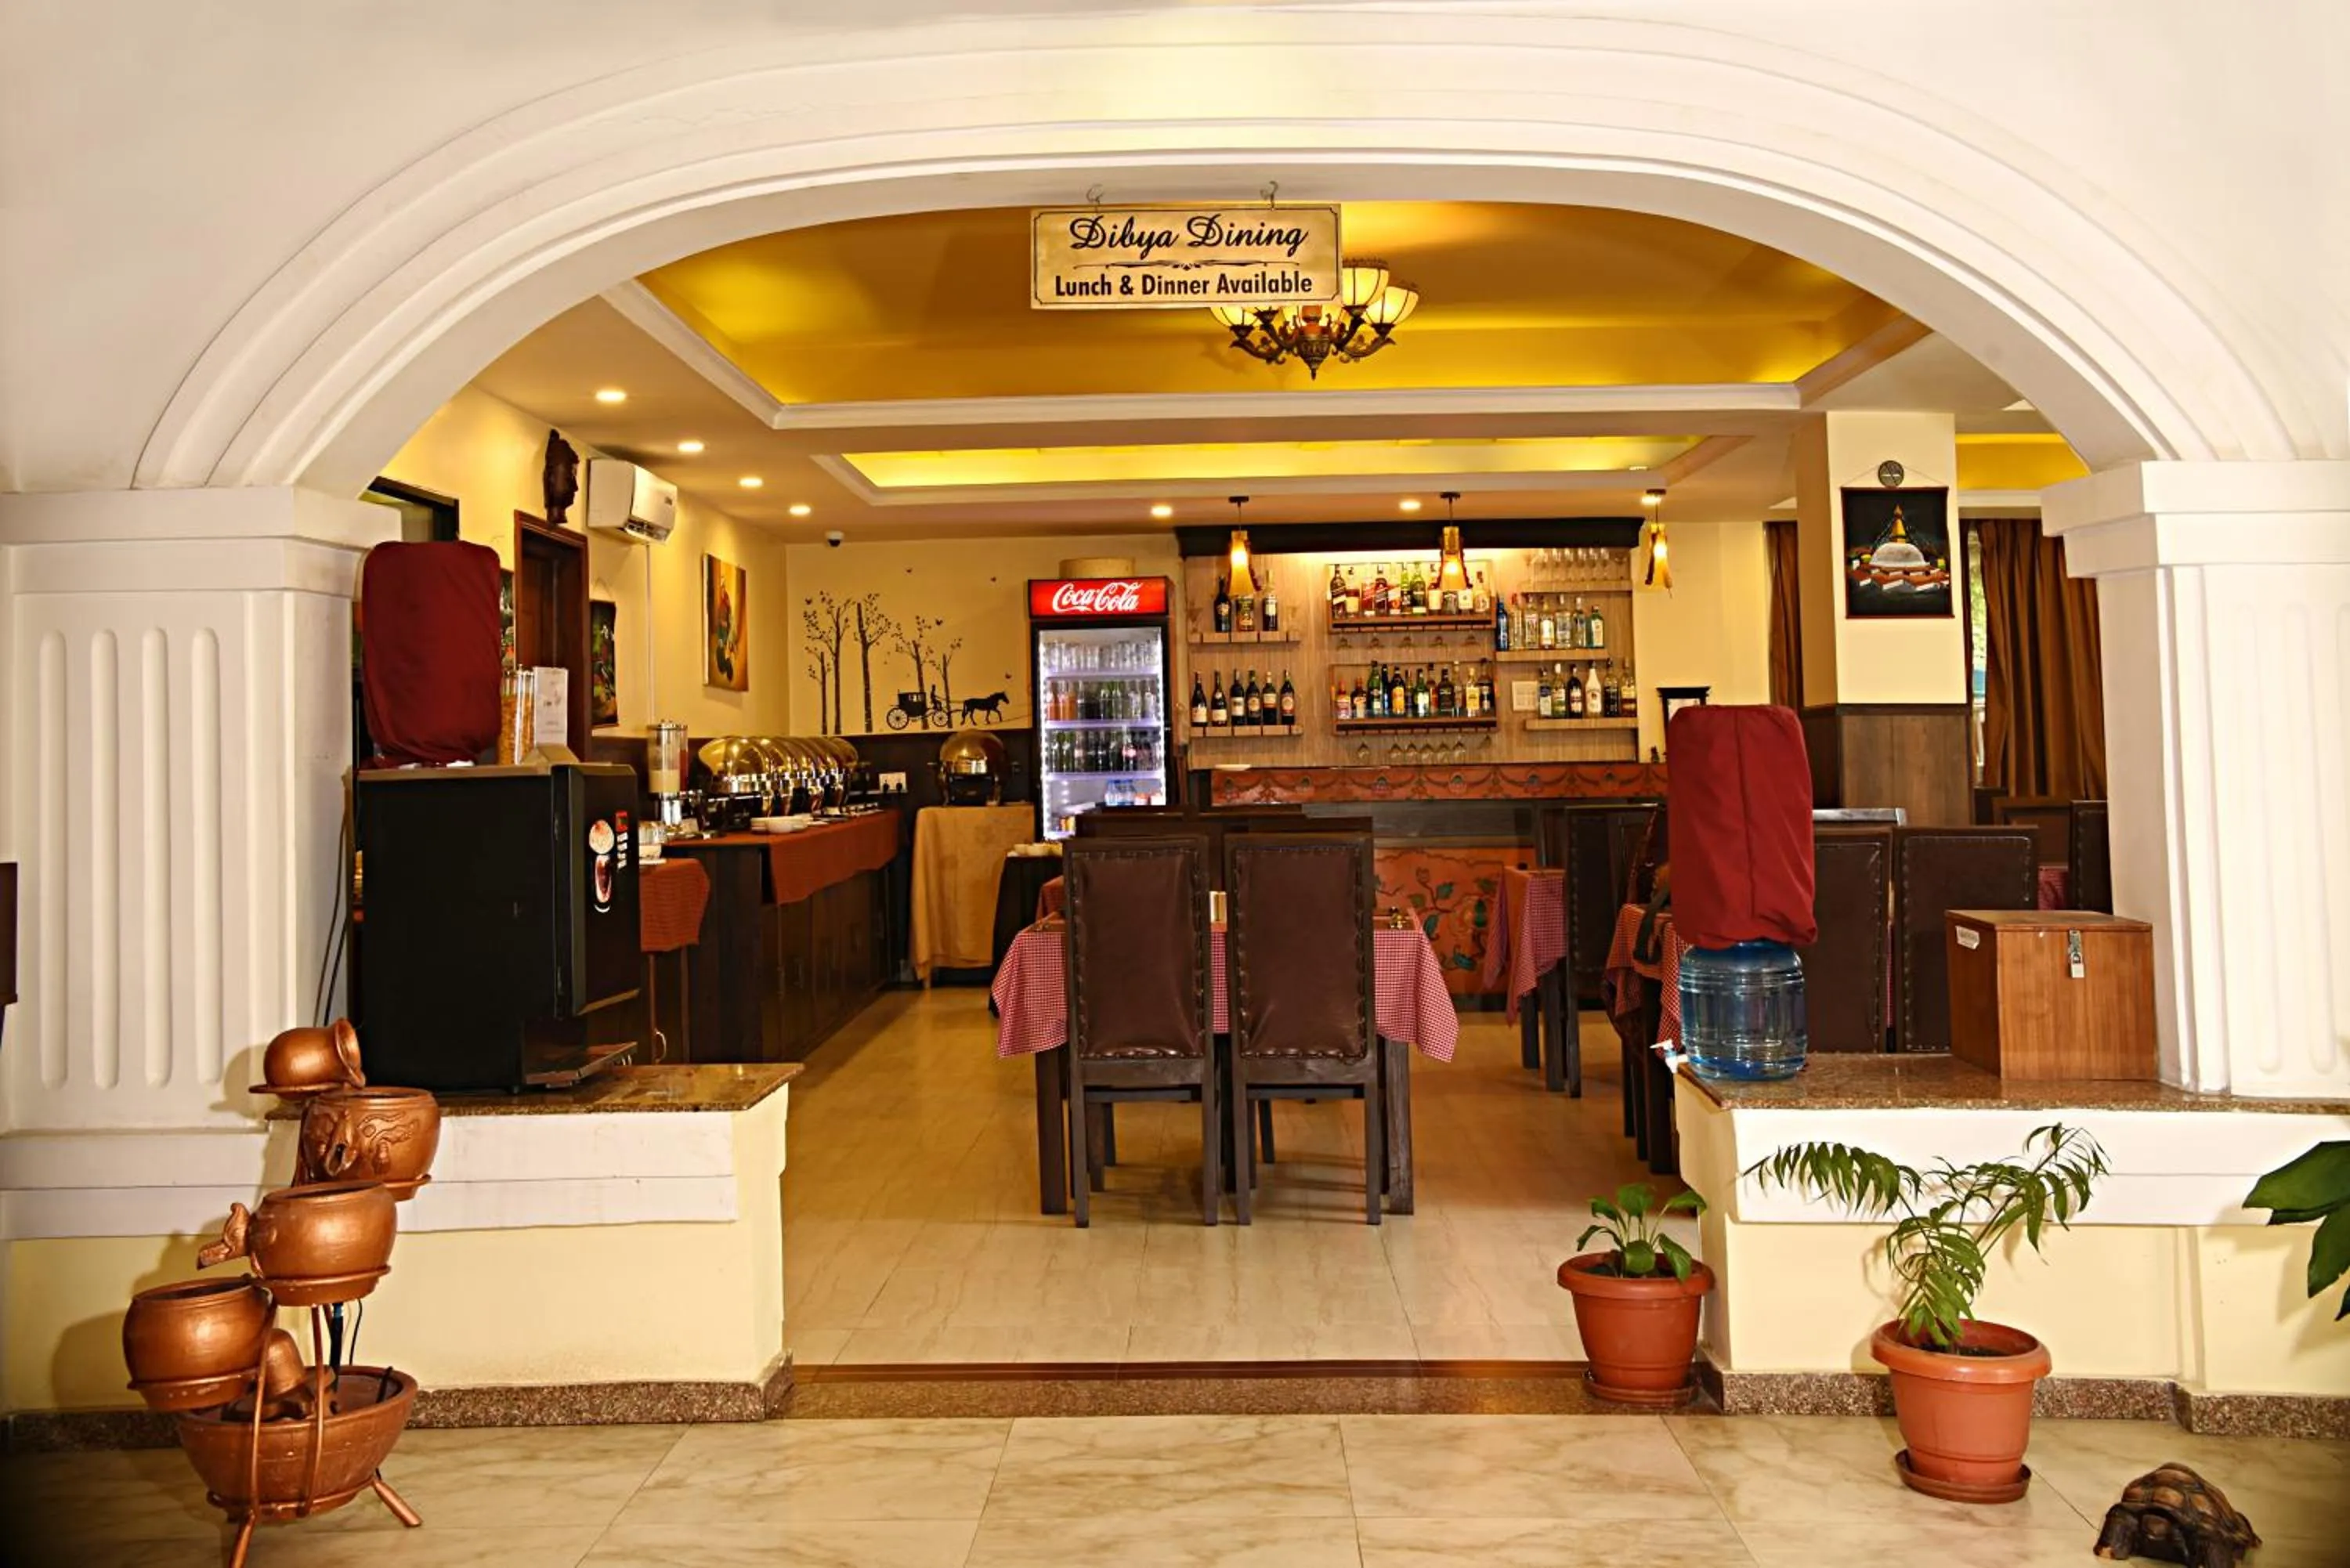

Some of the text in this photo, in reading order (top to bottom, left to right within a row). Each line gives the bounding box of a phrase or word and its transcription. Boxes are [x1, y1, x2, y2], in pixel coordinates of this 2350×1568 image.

[1070, 214, 1309, 260] Dibya Dining
[1055, 270, 1313, 297] Lunch & Dinner Available
